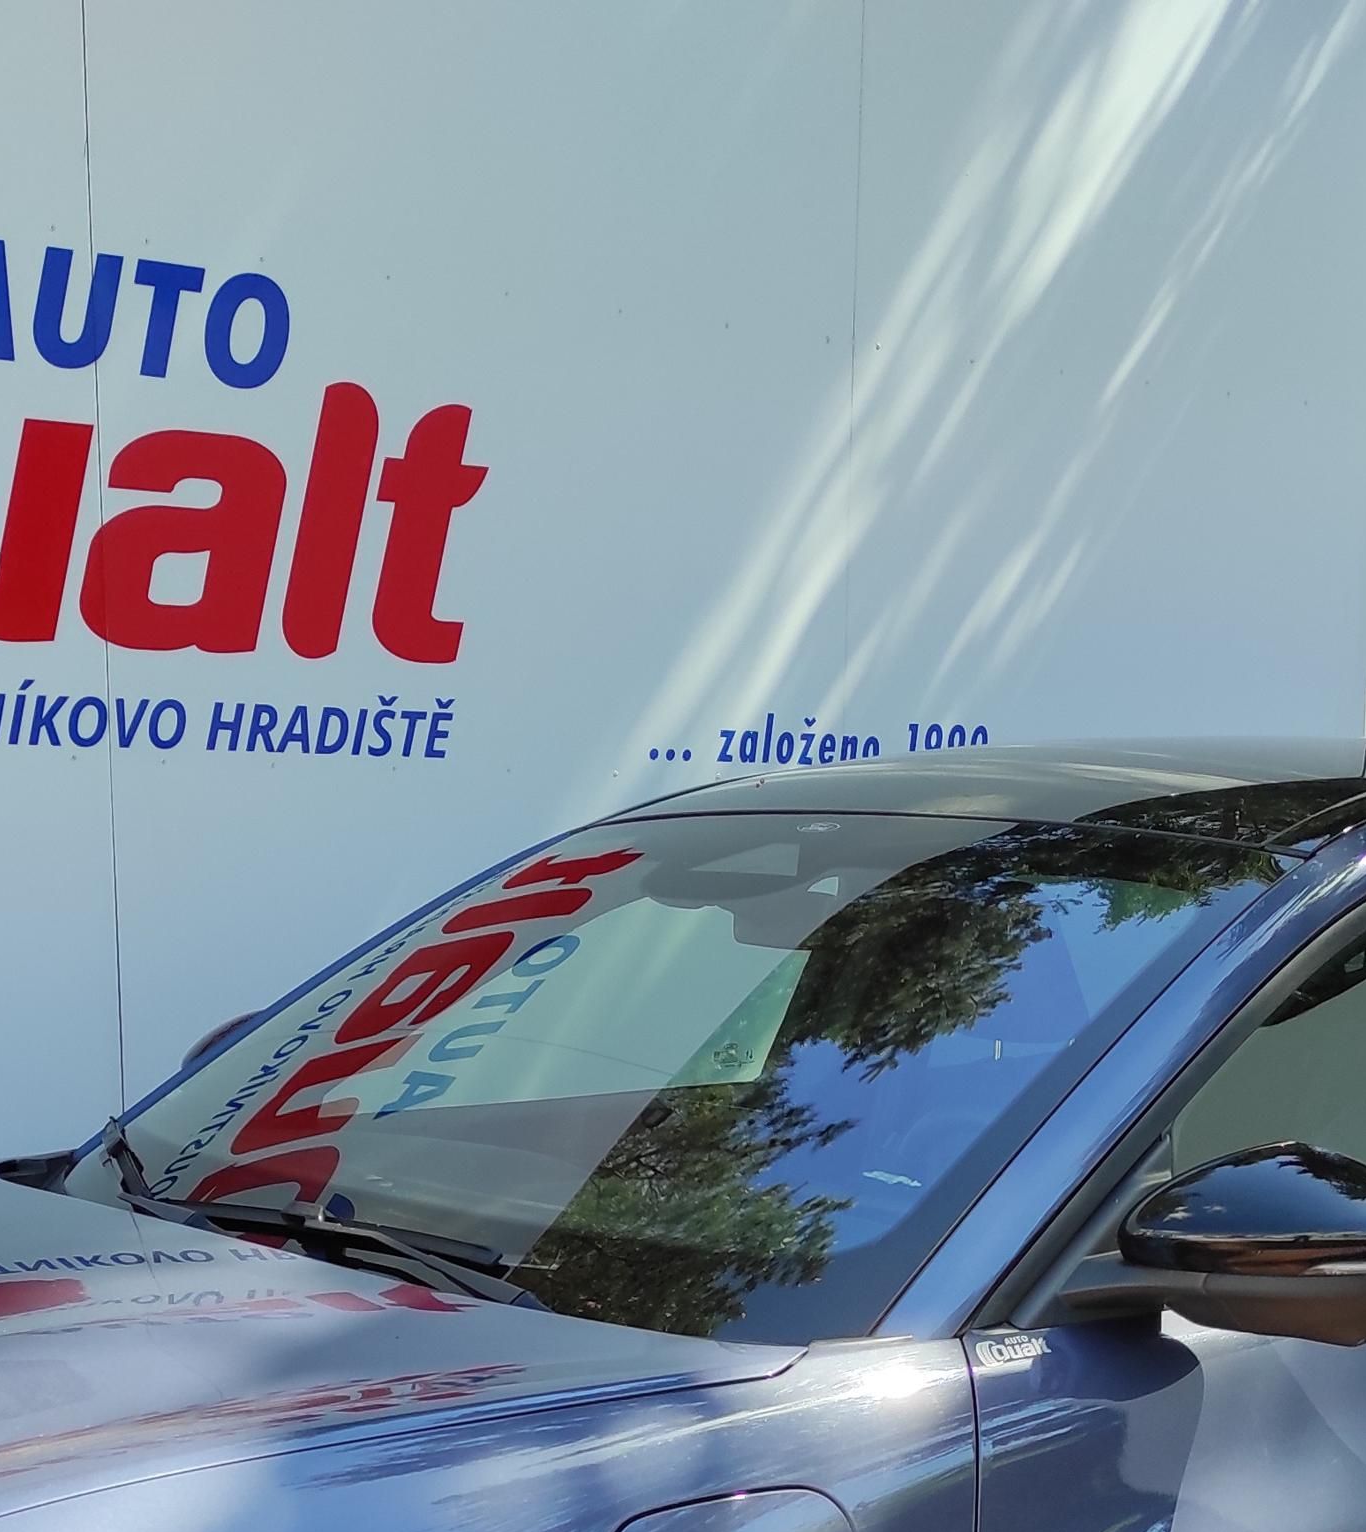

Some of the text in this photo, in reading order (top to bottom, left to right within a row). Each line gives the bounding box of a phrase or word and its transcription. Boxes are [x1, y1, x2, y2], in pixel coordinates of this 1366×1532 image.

[205, 695, 457, 760] HRADIŠTĚ
[717, 712, 880, 765] založeno
[1004, 1335, 1029, 1346] AUTO
